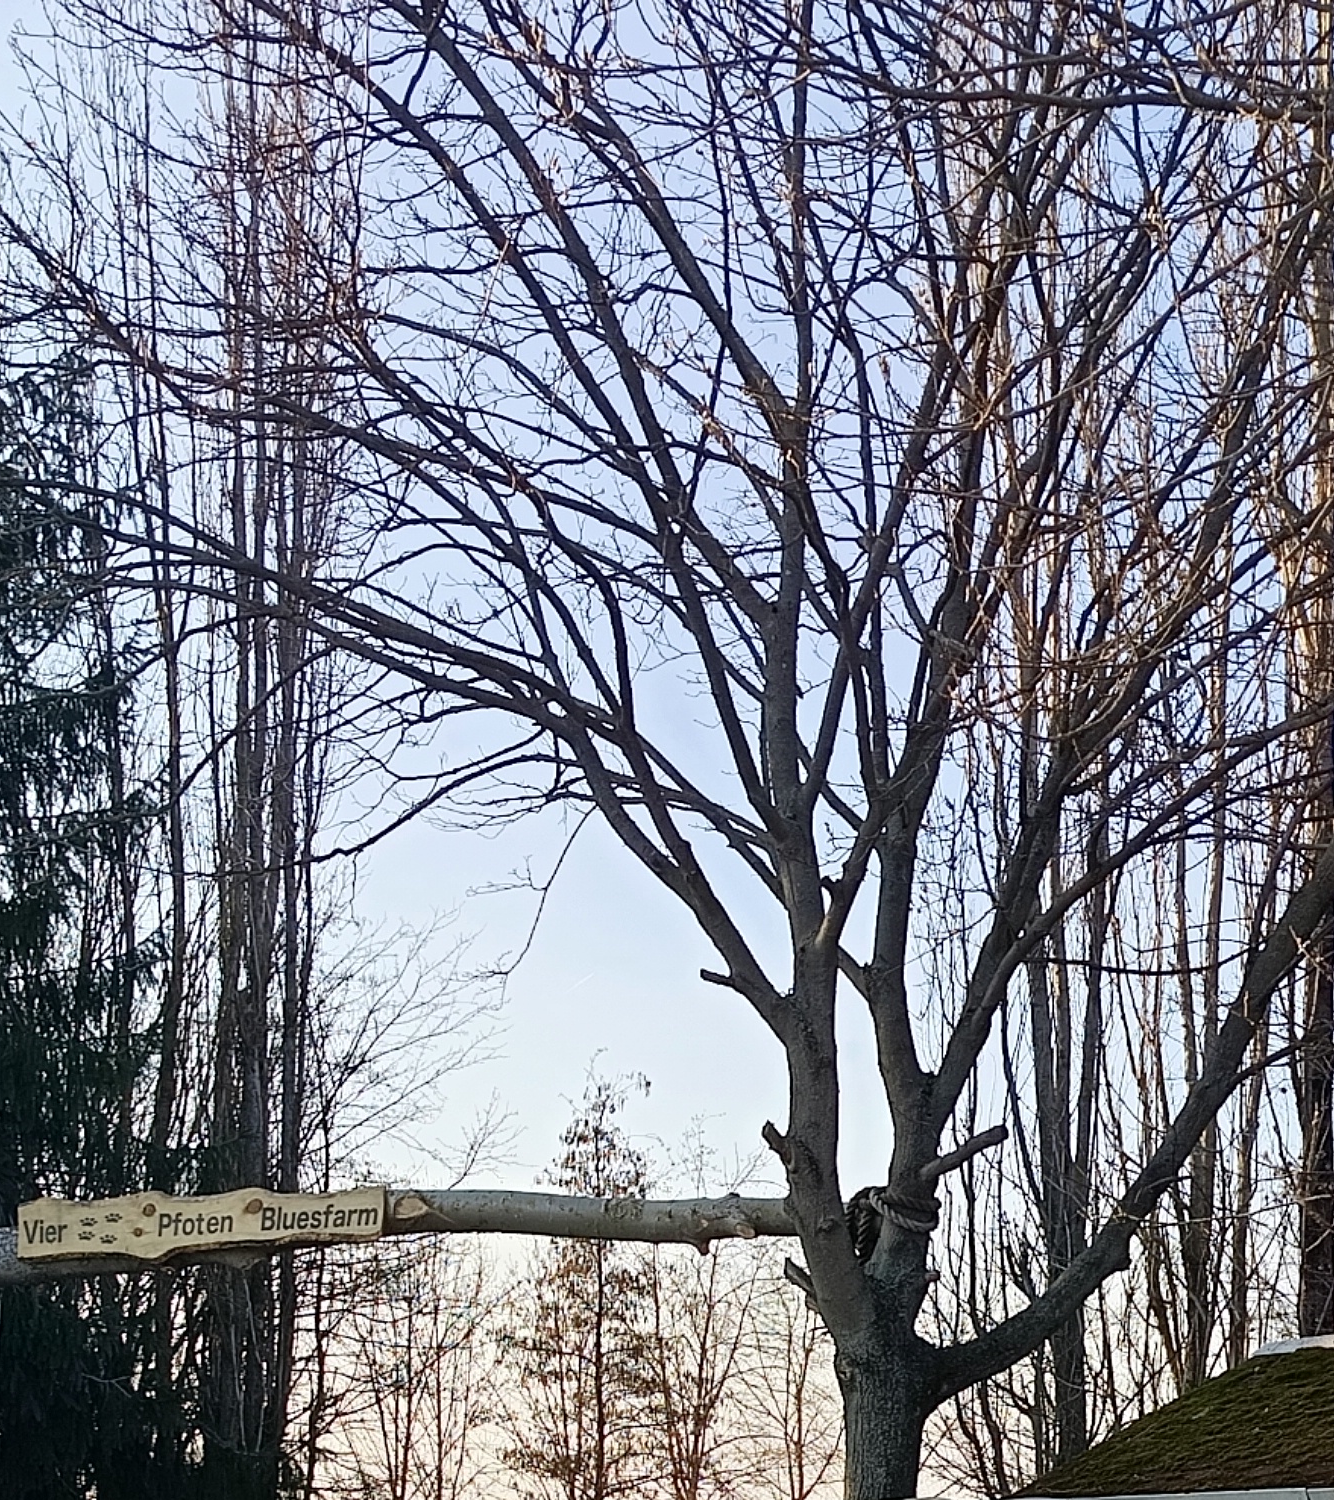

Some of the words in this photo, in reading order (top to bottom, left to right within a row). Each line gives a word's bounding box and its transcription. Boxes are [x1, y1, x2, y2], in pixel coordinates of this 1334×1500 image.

[23, 1219, 67, 1245] Vier
[157, 1211, 234, 1237] Pfoten
[260, 1205, 379, 1232] Bluesfarm
